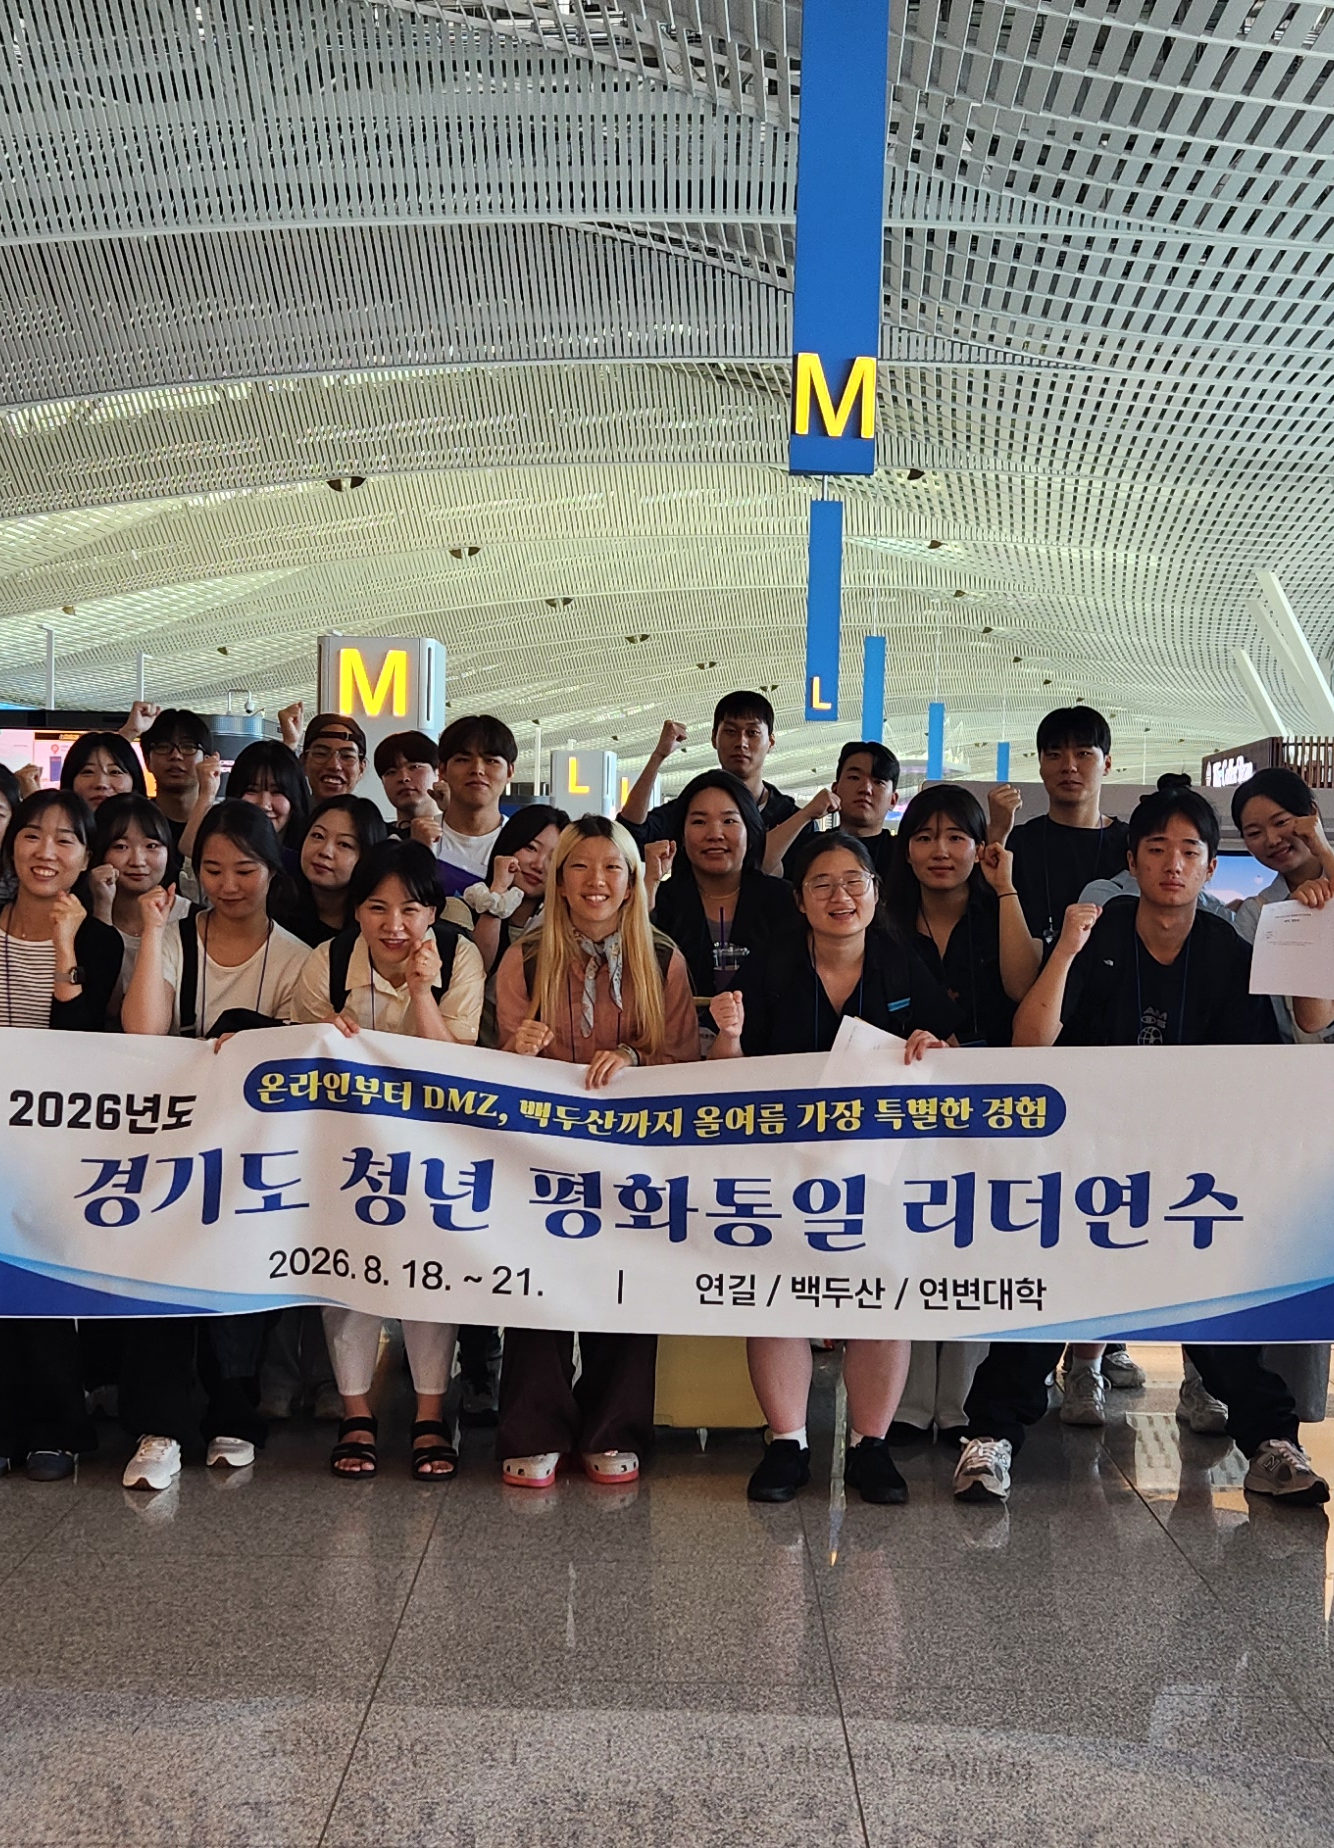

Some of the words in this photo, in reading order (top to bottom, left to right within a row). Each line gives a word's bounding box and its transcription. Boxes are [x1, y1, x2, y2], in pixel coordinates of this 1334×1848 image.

[794, 352, 877, 439] M
[340, 648, 407, 717] M
[811, 676, 832, 710] L
[569, 756, 590, 793] L
[9, 1089, 197, 1135] 2026년도
[256, 1070, 411, 1111] 온라인부터
[423, 1085, 509, 1127] DMZ,
[520, 1099, 683, 1139] 백두산까지
[693, 1101, 788, 1138] 올여름
[797, 1099, 865, 1133] 가장
[874, 1096, 973, 1131] 특별한
[982, 1095, 1047, 1130] 경험
[73, 1147, 311, 1228] 경기도
[340, 1146, 495, 1232] 청년
[529, 1166, 867, 1253] 평화통일
[903, 1170, 1244, 1252] 리더연수
[695, 1273, 757, 1306] 연길
[791, 1275, 885, 1309] 백두산
[918, 1277, 1047, 1311] 연변대학
